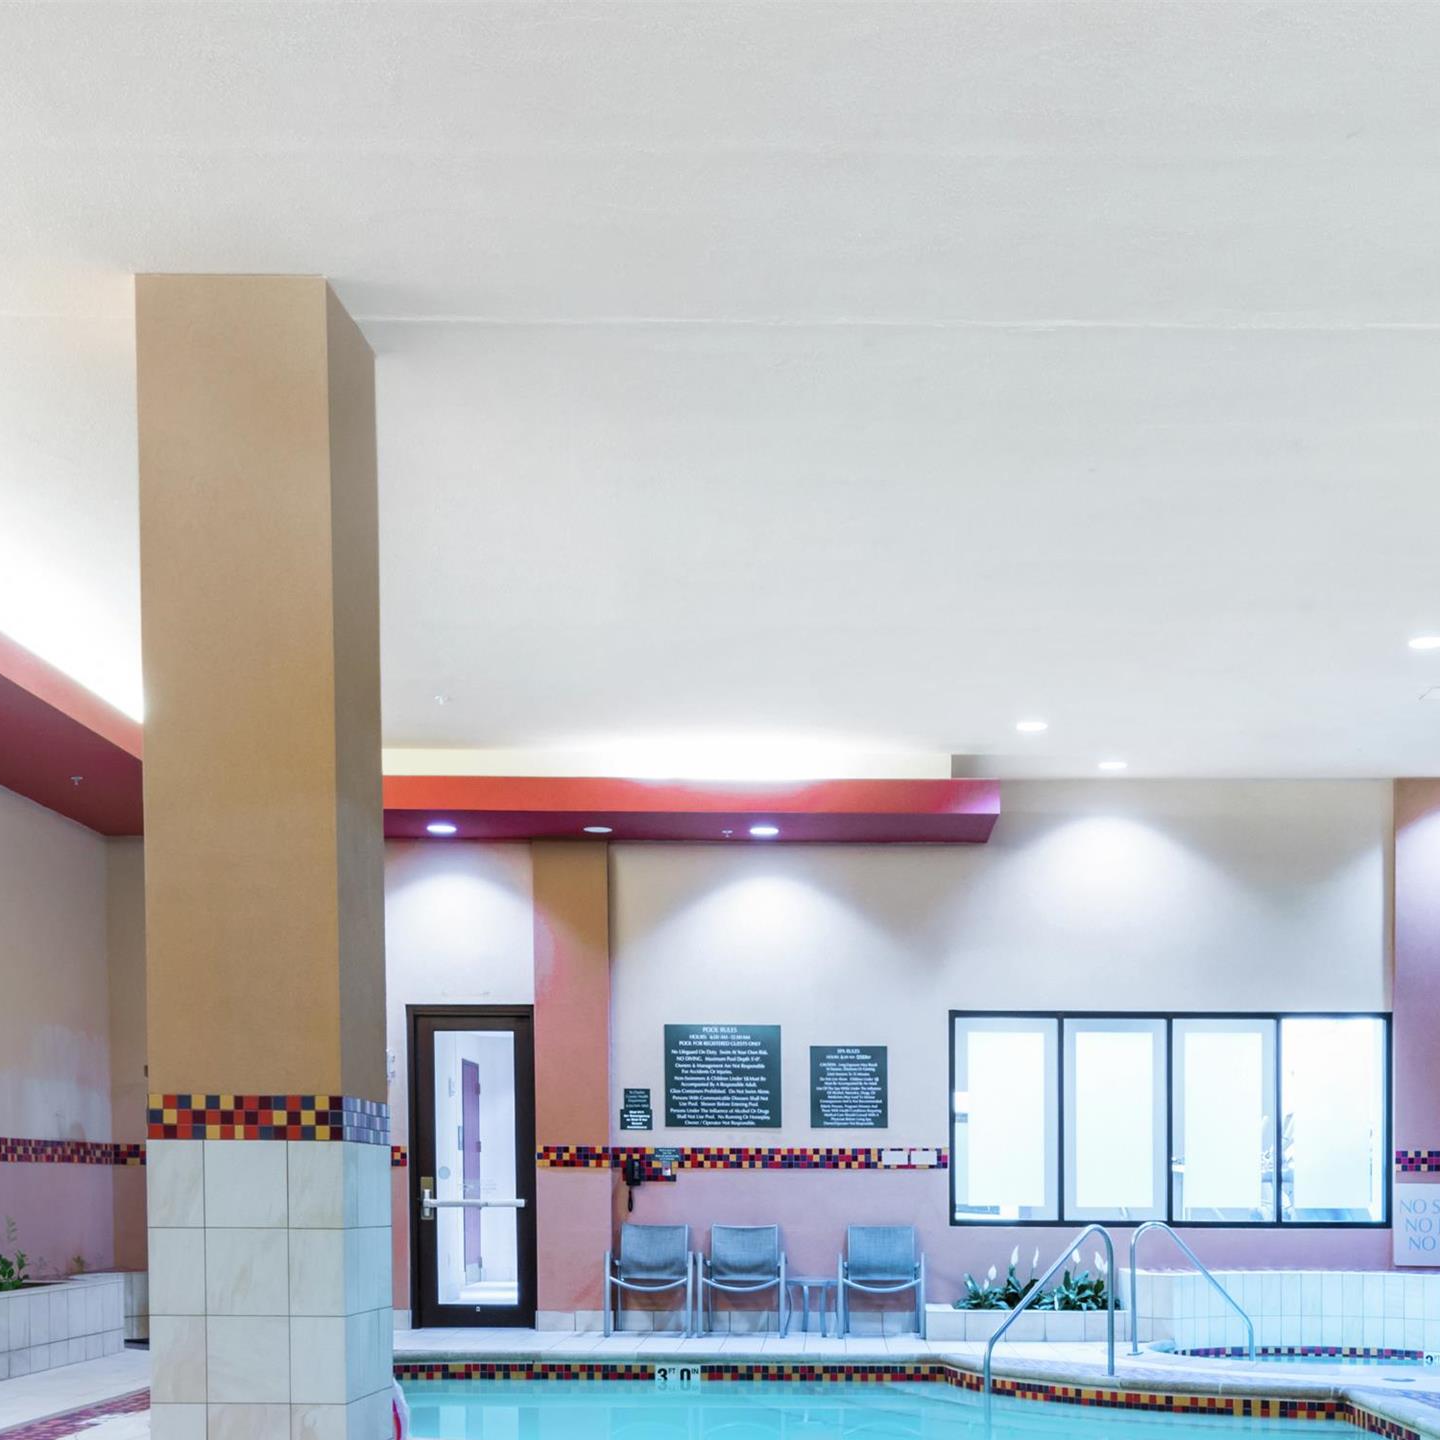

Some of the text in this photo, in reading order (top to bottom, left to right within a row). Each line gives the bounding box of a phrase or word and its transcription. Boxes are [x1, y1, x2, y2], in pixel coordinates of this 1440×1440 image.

[1400, 1200, 1427, 1215] NO
[1405, 1218, 1432, 1234] NO
[1409, 1236, 1436, 1252] NO
